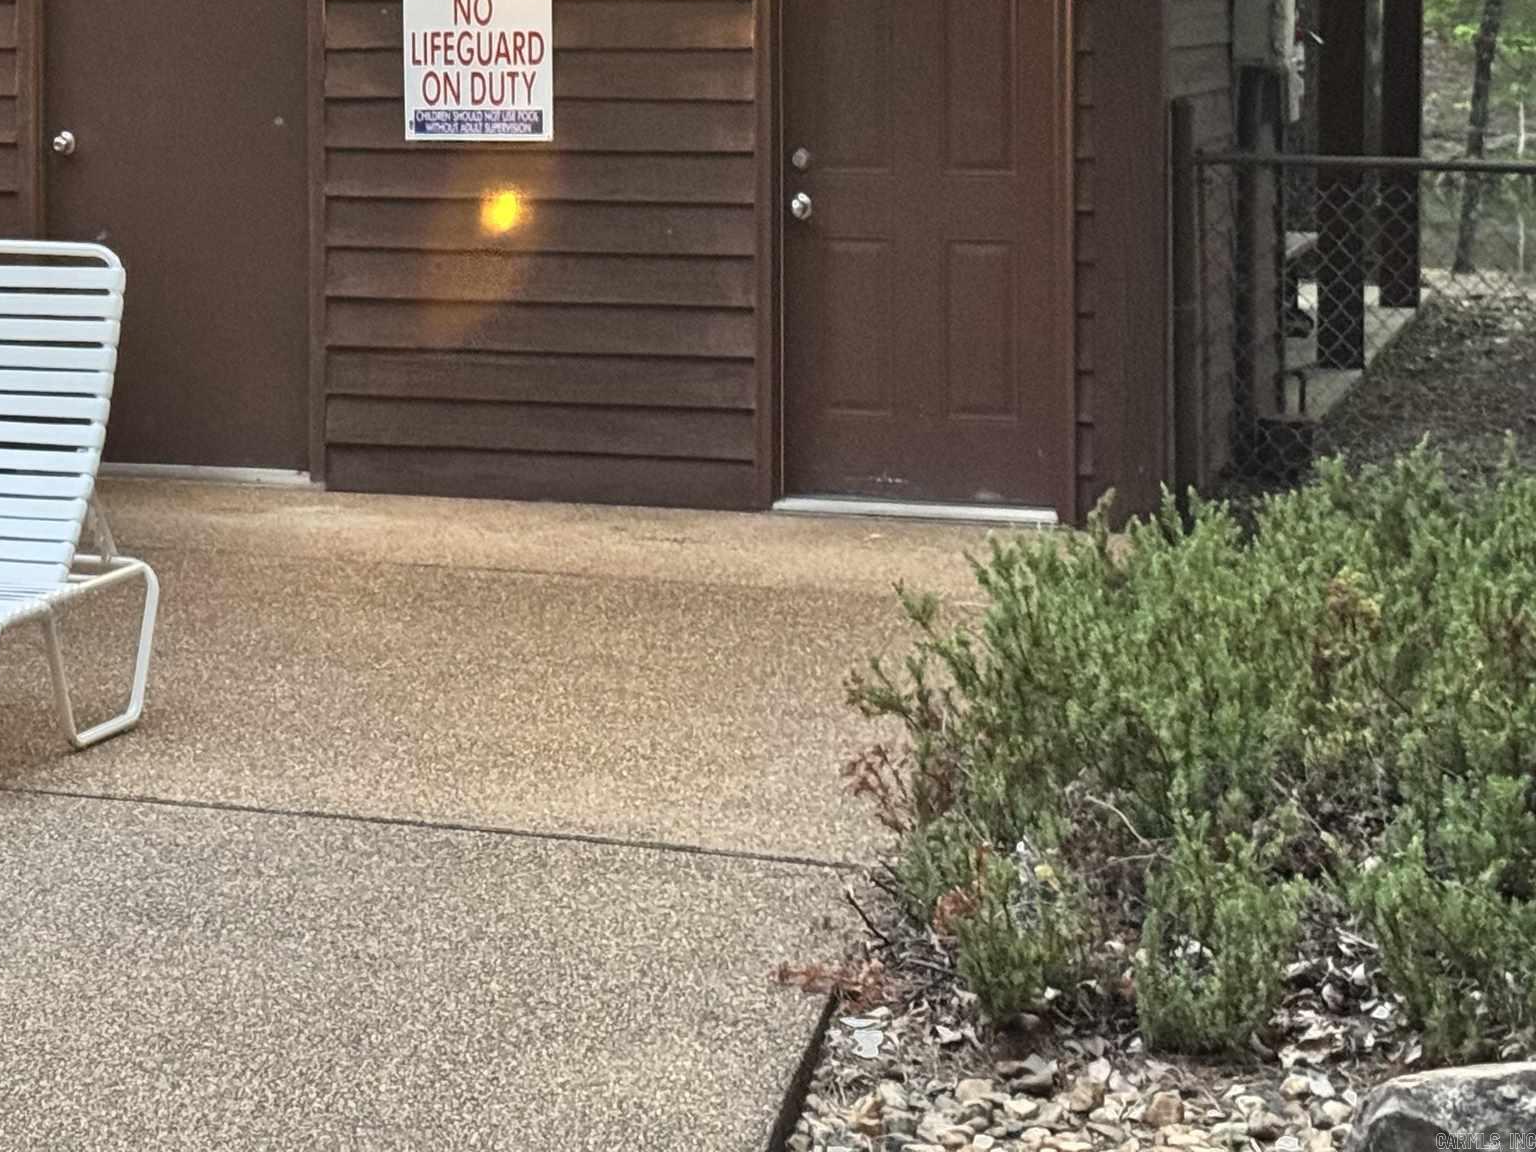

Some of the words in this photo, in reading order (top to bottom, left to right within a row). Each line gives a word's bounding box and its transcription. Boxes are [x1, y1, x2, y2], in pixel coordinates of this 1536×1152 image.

[411, 30, 545, 66] LIFEGUARD
[422, 70, 461, 106] ON
[470, 70, 537, 106] DUTY
